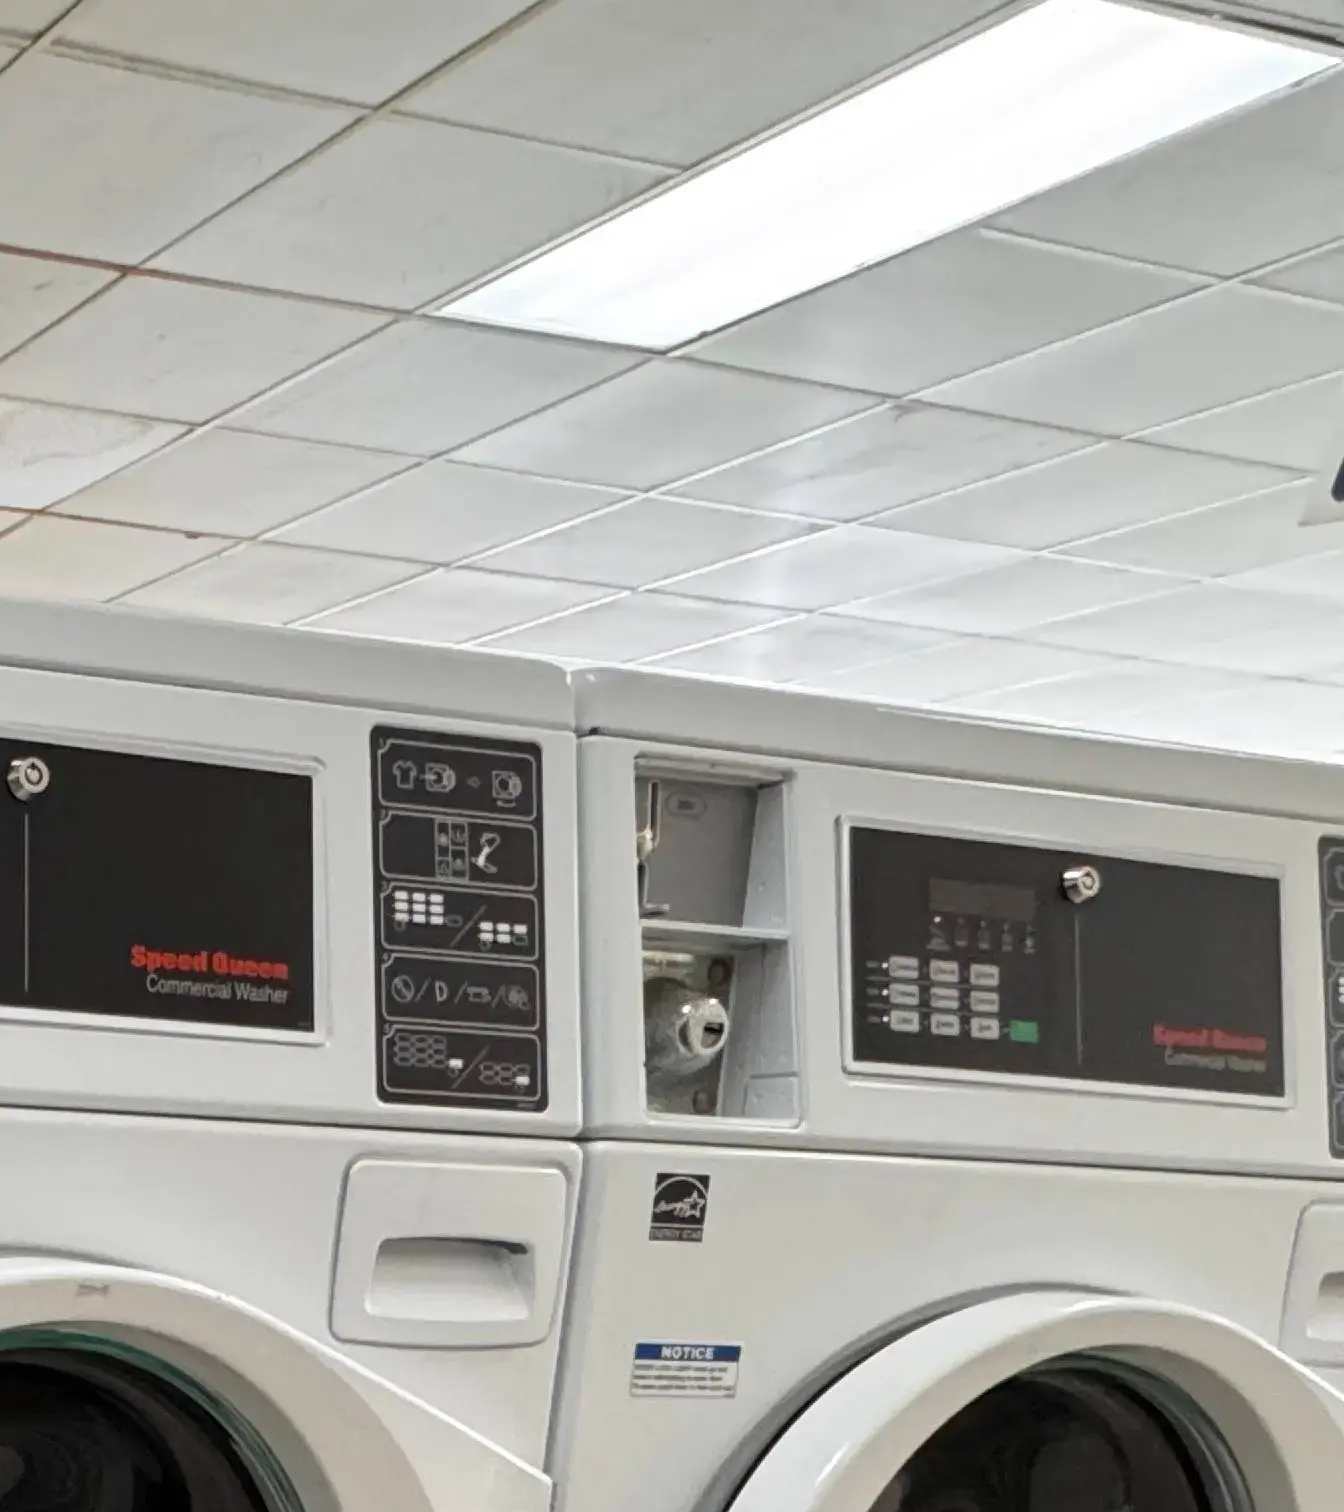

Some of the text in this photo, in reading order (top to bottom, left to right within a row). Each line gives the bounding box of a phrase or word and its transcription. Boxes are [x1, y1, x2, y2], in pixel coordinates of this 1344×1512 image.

[130, 944, 289, 980] Speed Queen
[146, 974, 289, 1004] Commercial Washer
[660, 1345, 715, 1360] NOTICE
